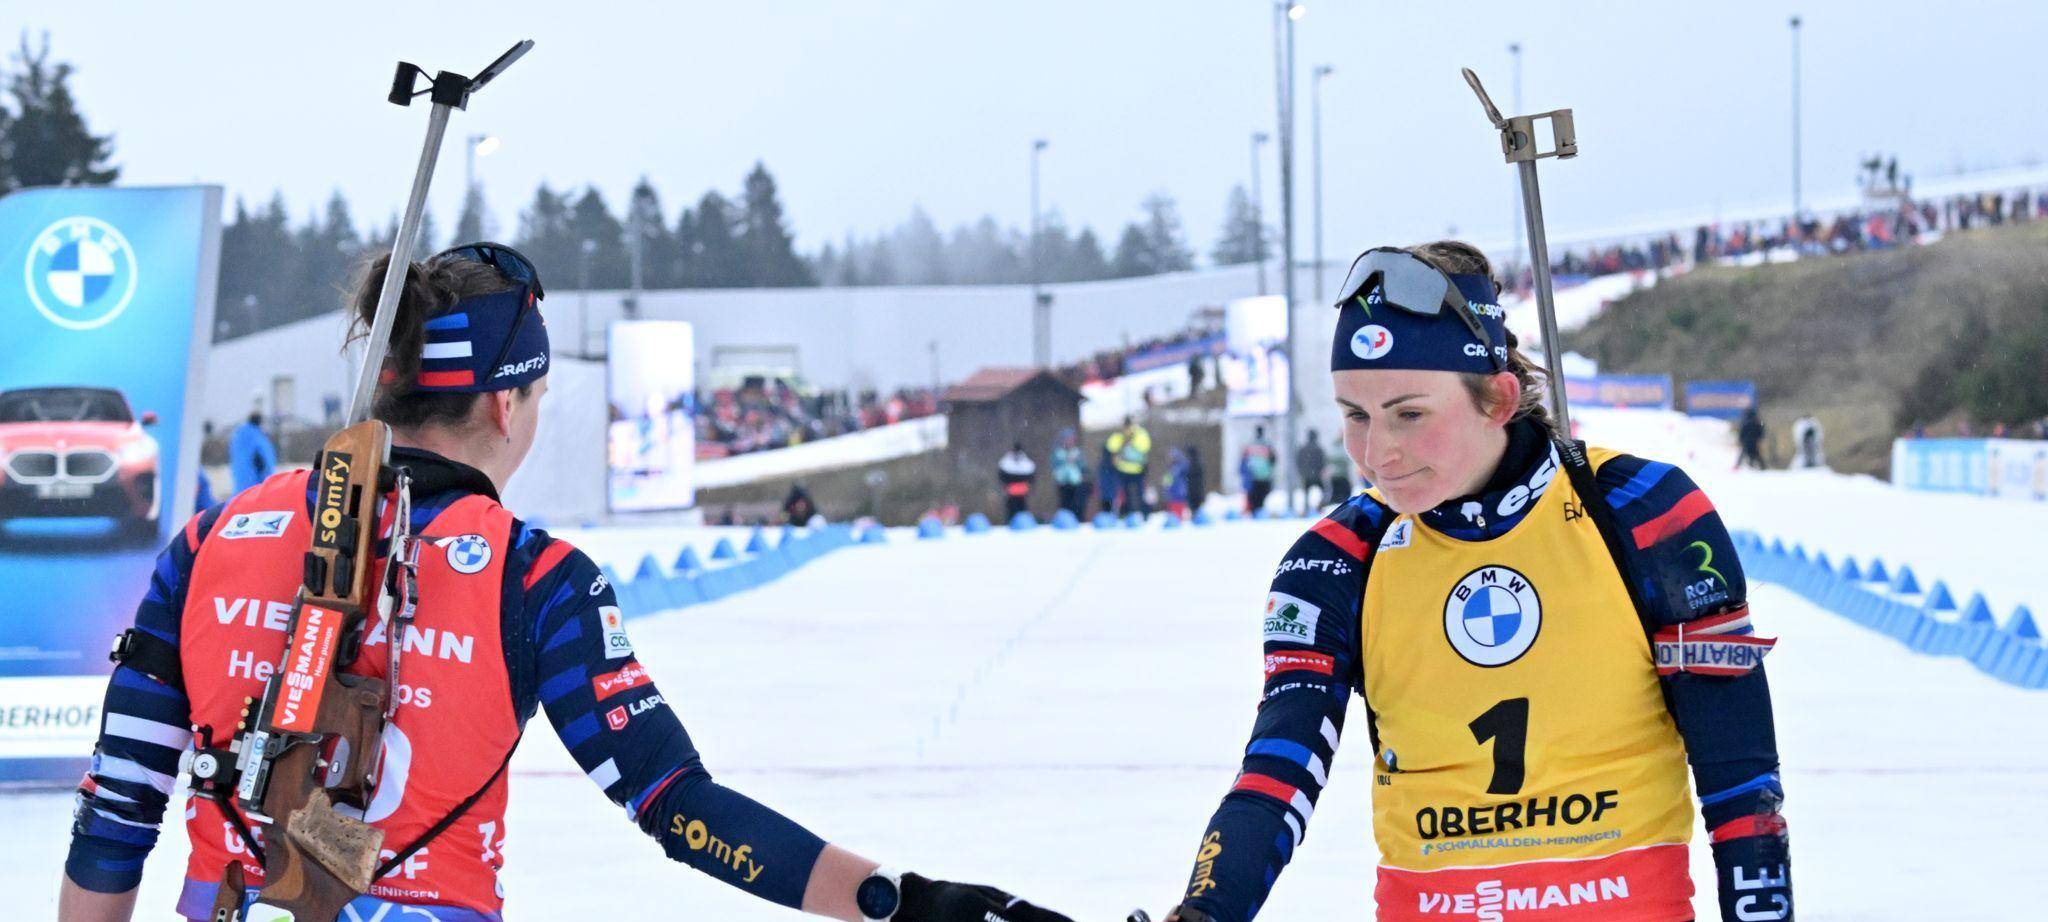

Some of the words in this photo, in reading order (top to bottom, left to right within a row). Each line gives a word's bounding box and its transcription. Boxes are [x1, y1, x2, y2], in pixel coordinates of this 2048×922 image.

[321, 457, 350, 544] somfy
[1455, 570, 1526, 602] BMW
[1685, 577, 1715, 600] ROY
[320, 626, 334, 655] pumps
[282, 608, 324, 726] VIESSMANN
[313, 653, 330, 677] Heat
[1467, 697, 1529, 795] 1
[1415, 790, 1619, 840] OBERHOF
[670, 813, 764, 883] somfy
[1436, 829, 1622, 853] SCHMALKALDEN-MEININGEN
[1418, 875, 1631, 922] VIESSMANN
[1733, 863, 1790, 922] CE
